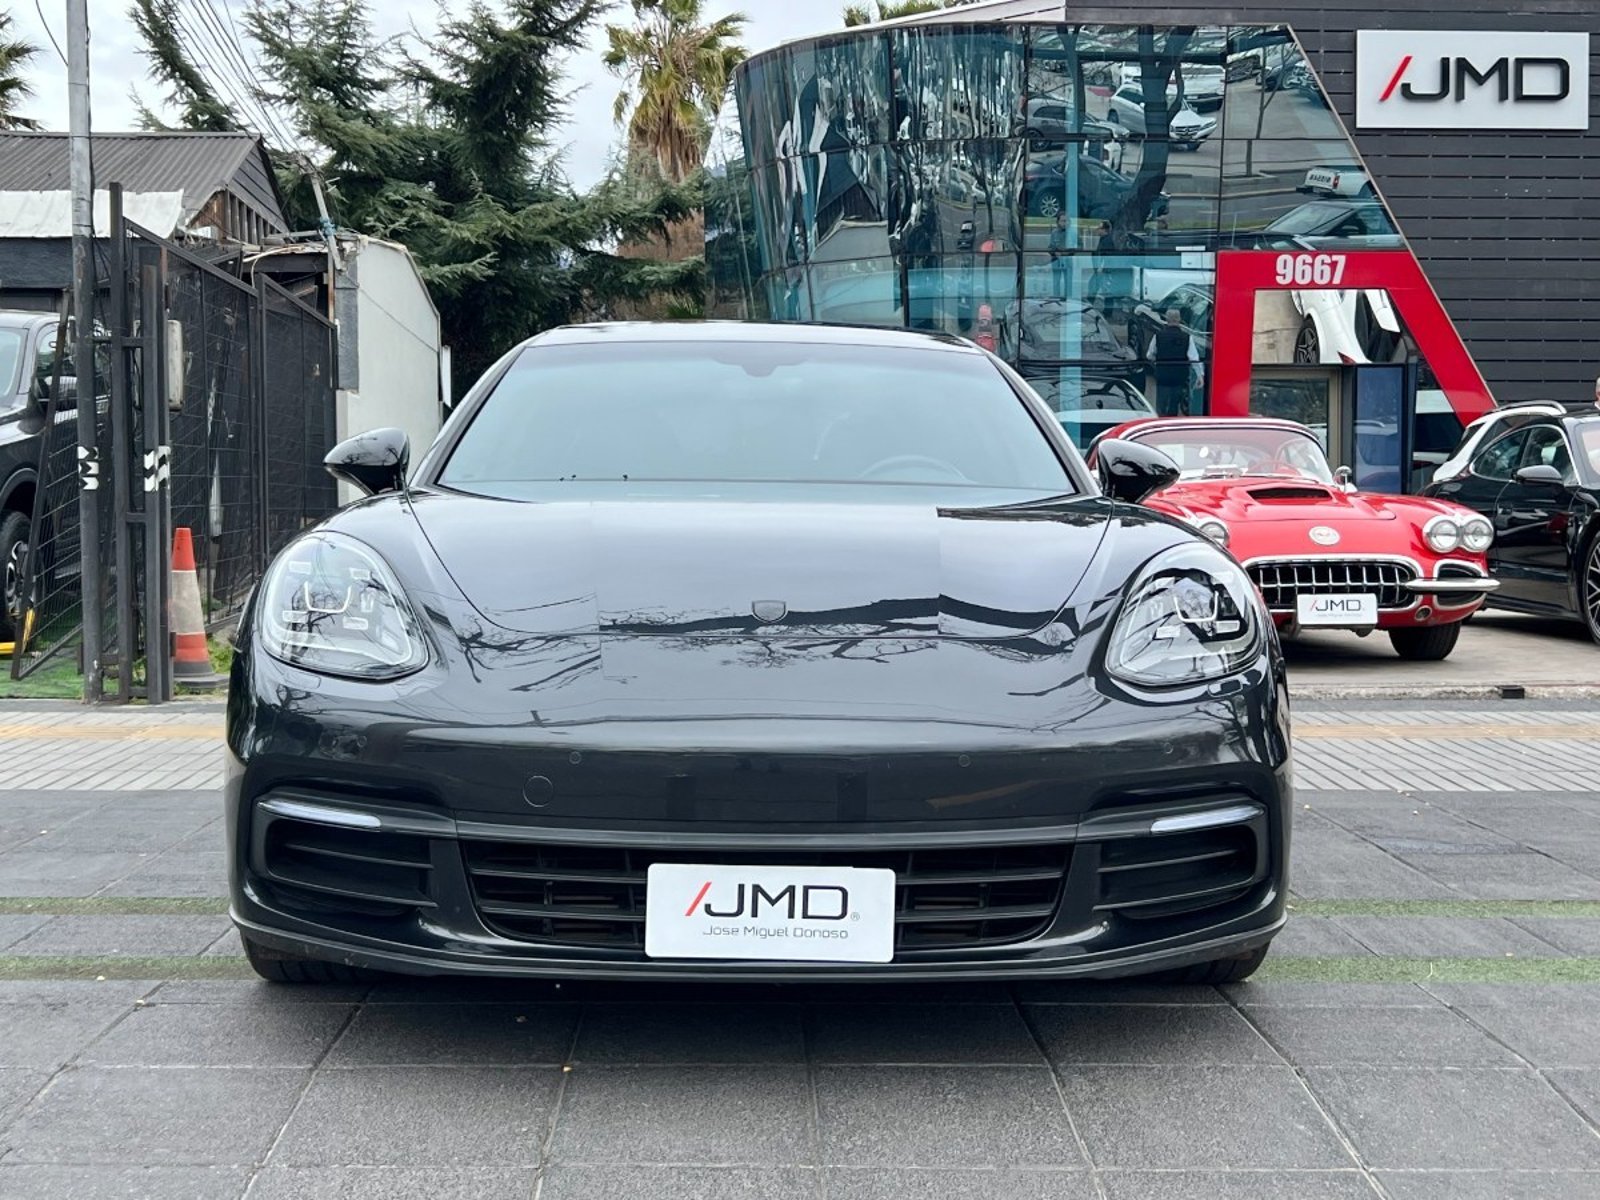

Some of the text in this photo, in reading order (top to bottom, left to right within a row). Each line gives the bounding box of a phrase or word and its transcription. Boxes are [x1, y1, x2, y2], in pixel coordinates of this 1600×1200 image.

[1275, 254, 1347, 285] 9667
[702, 925, 849, 940] Jose Miguel Donoso
